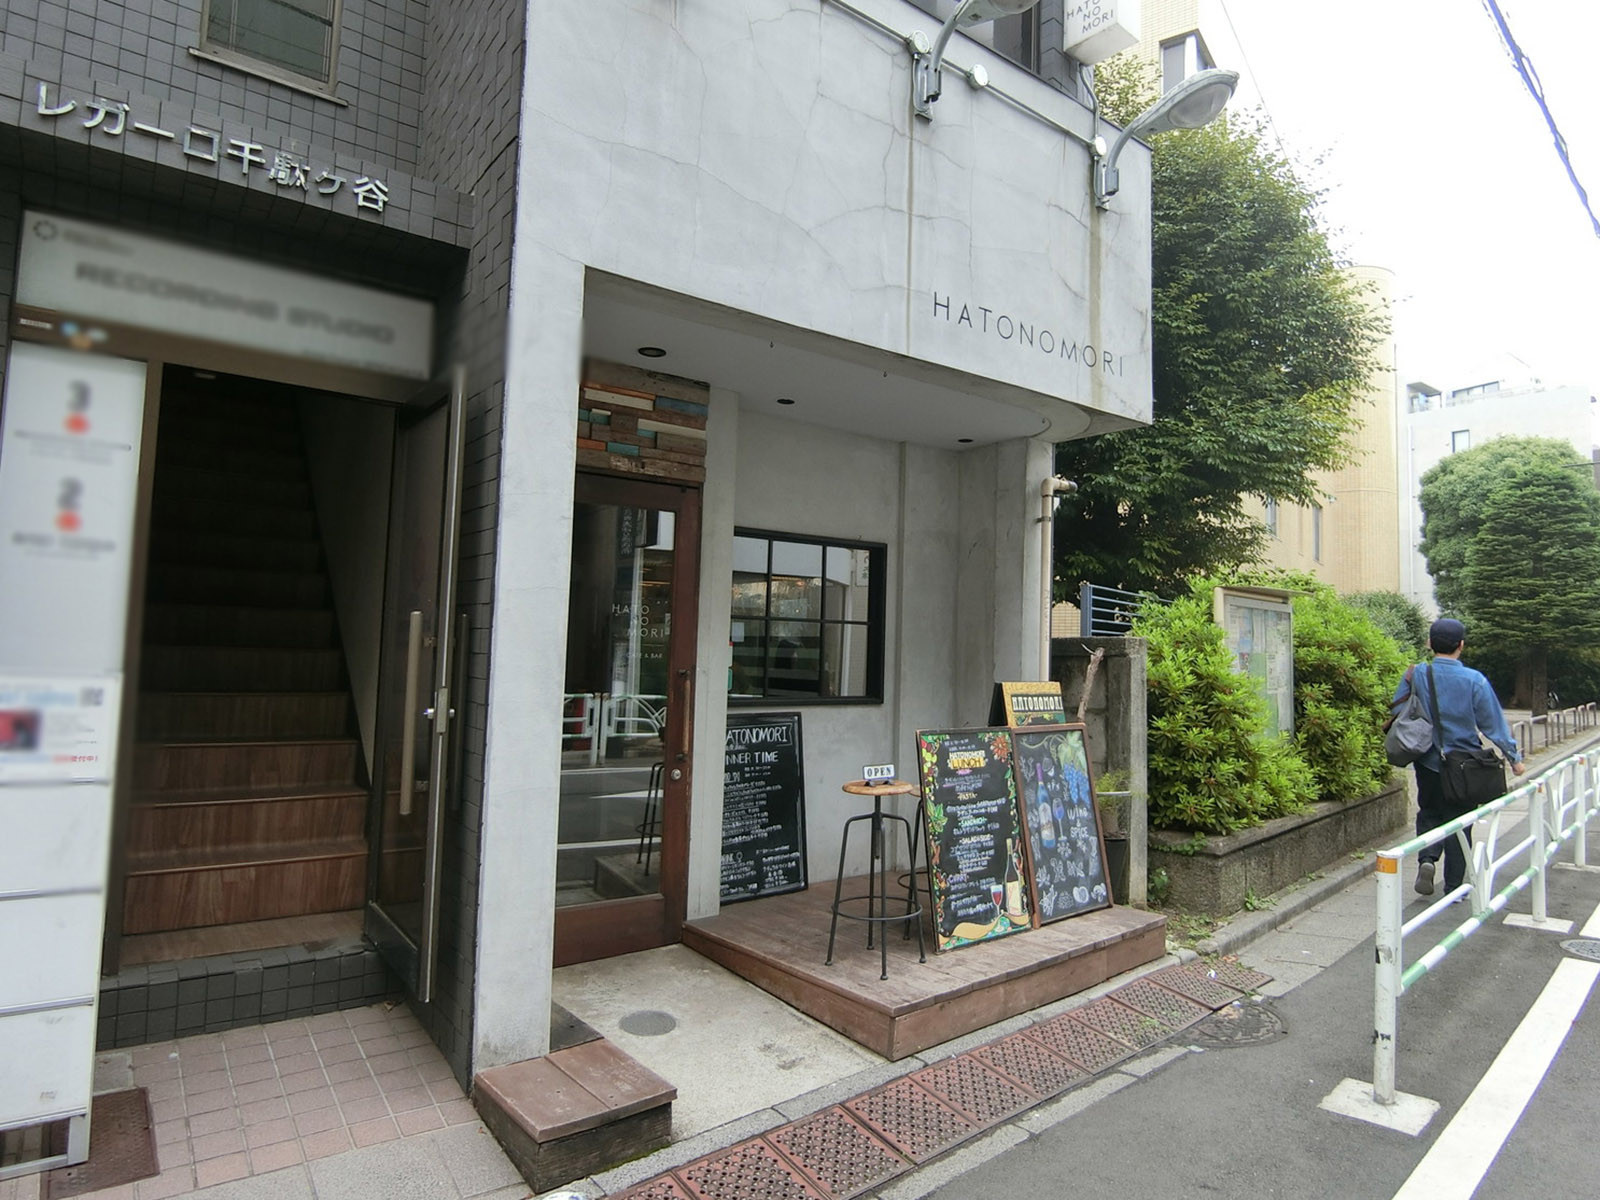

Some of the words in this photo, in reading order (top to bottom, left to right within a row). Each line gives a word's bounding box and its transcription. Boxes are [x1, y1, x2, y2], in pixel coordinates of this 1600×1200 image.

[1083, 6, 1101, 21] NO
[1082, 9, 1113, 34] MORI
[933, 291, 1124, 377] HATONOMORI
[726, 726, 787, 744] ATONOMORI
[754, 750, 779, 764] TIME
[951, 757, 985, 769] LUNCH
[867, 766, 892, 778] OPEN
